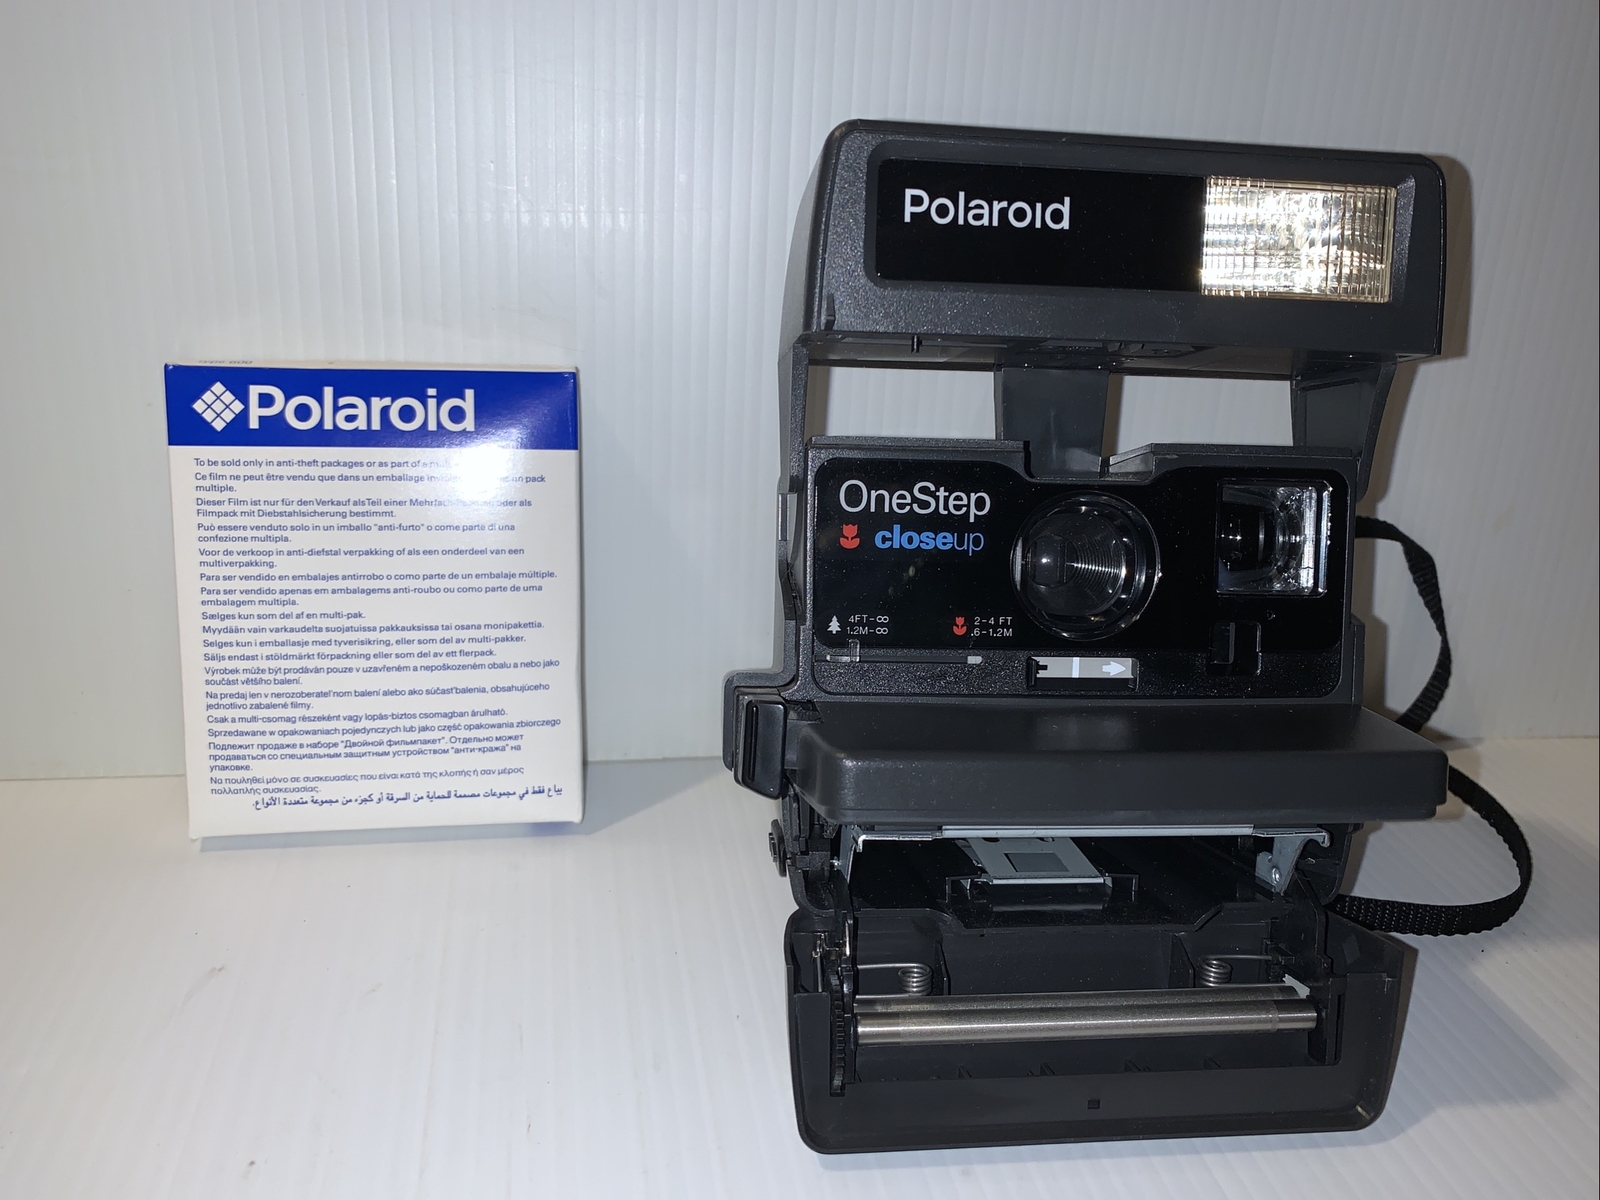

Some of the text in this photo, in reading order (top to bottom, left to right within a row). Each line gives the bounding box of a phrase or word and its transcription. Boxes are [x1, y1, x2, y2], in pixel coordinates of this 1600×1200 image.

[904, 188, 1071, 230] Polaroid
[249, 384, 475, 432] Polaroid
[194, 458, 205, 466] To
[243, 459, 264, 468] only
[276, 459, 319, 467] anti-theft
[321, 460, 364, 469] packages
[196, 498, 226, 506] Dieser
[228, 498, 248, 506] Film
[250, 498, 261, 506] ist
[281, 498, 295, 506] für
[840, 480, 990, 523] OneStep
[196, 509, 238, 518] Filmpack
[240, 509, 256, 517] mit
[257, 509, 347, 519] Diebstahlsicherung
[875, 524, 983, 556] closeup
[199, 548, 221, 556] Voor
[223, 548, 234, 556] de
[236, 548, 274, 557] verkoop
[276, 548, 284, 556] in
[286, 548, 341, 556] anti-diefstal
[343, 548, 394, 557] verpakking
[396, 548, 406, 556] of
[199, 559, 277, 569] multiverpakking.
[200, 587, 221, 595] Para
[239, 587, 277, 595] vendido
[331, 587, 391, 596] ambalagems
[393, 586, 441, 594] anti-roubo
[485, 586, 508, 594] parte
[510, 584, 521, 592] de
[201, 598, 299, 607] embalagem multipla.
[201, 612, 236, 621] Sælges
[238, 612, 255, 620] kun
[295, 611, 305, 619] af
[320, 611, 366, 620] multi-pak.
[999, 616, 1013, 626] FT
[202, 626, 245, 635] Myydään
[269, 625, 323, 633] varkaudelta
[325, 624, 377, 634] suojatuissa
[379, 624, 439, 633] pakkauksissa
[441, 623, 452, 631] tai
[484, 621, 545, 630] monipakettia.
[203, 639, 234, 649] Selges
[254, 639, 257, 647] i
[259, 639, 309, 648] emballasje
[334, 638, 394, 647] tyverisikring,
[468, 635, 526, 644] multi-pakker.
[207, 715, 229, 723] Csak
[238, 715, 297, 724] multi-csomag
[342, 715, 363, 723] vagy
[419, 710, 469, 719] csomagban
[208, 729, 267, 738] Sprzedawane
[278, 727, 340, 737] opakowaniach
[342, 725, 401, 735] pojedynczych
[417, 724, 436, 734] jako
[464, 721, 514, 731] opakowania
[516, 719, 561, 728] zbiorczego
[209, 742, 255, 751] Подлежит
[257, 743, 297, 751] продаже
[306, 741, 339, 749] наборе
[450, 736, 494, 744] Отдельно
[344, 750, 390, 758] защитным
[392, 747, 450, 757] устройством
[210, 765, 253, 773] упаковке.
